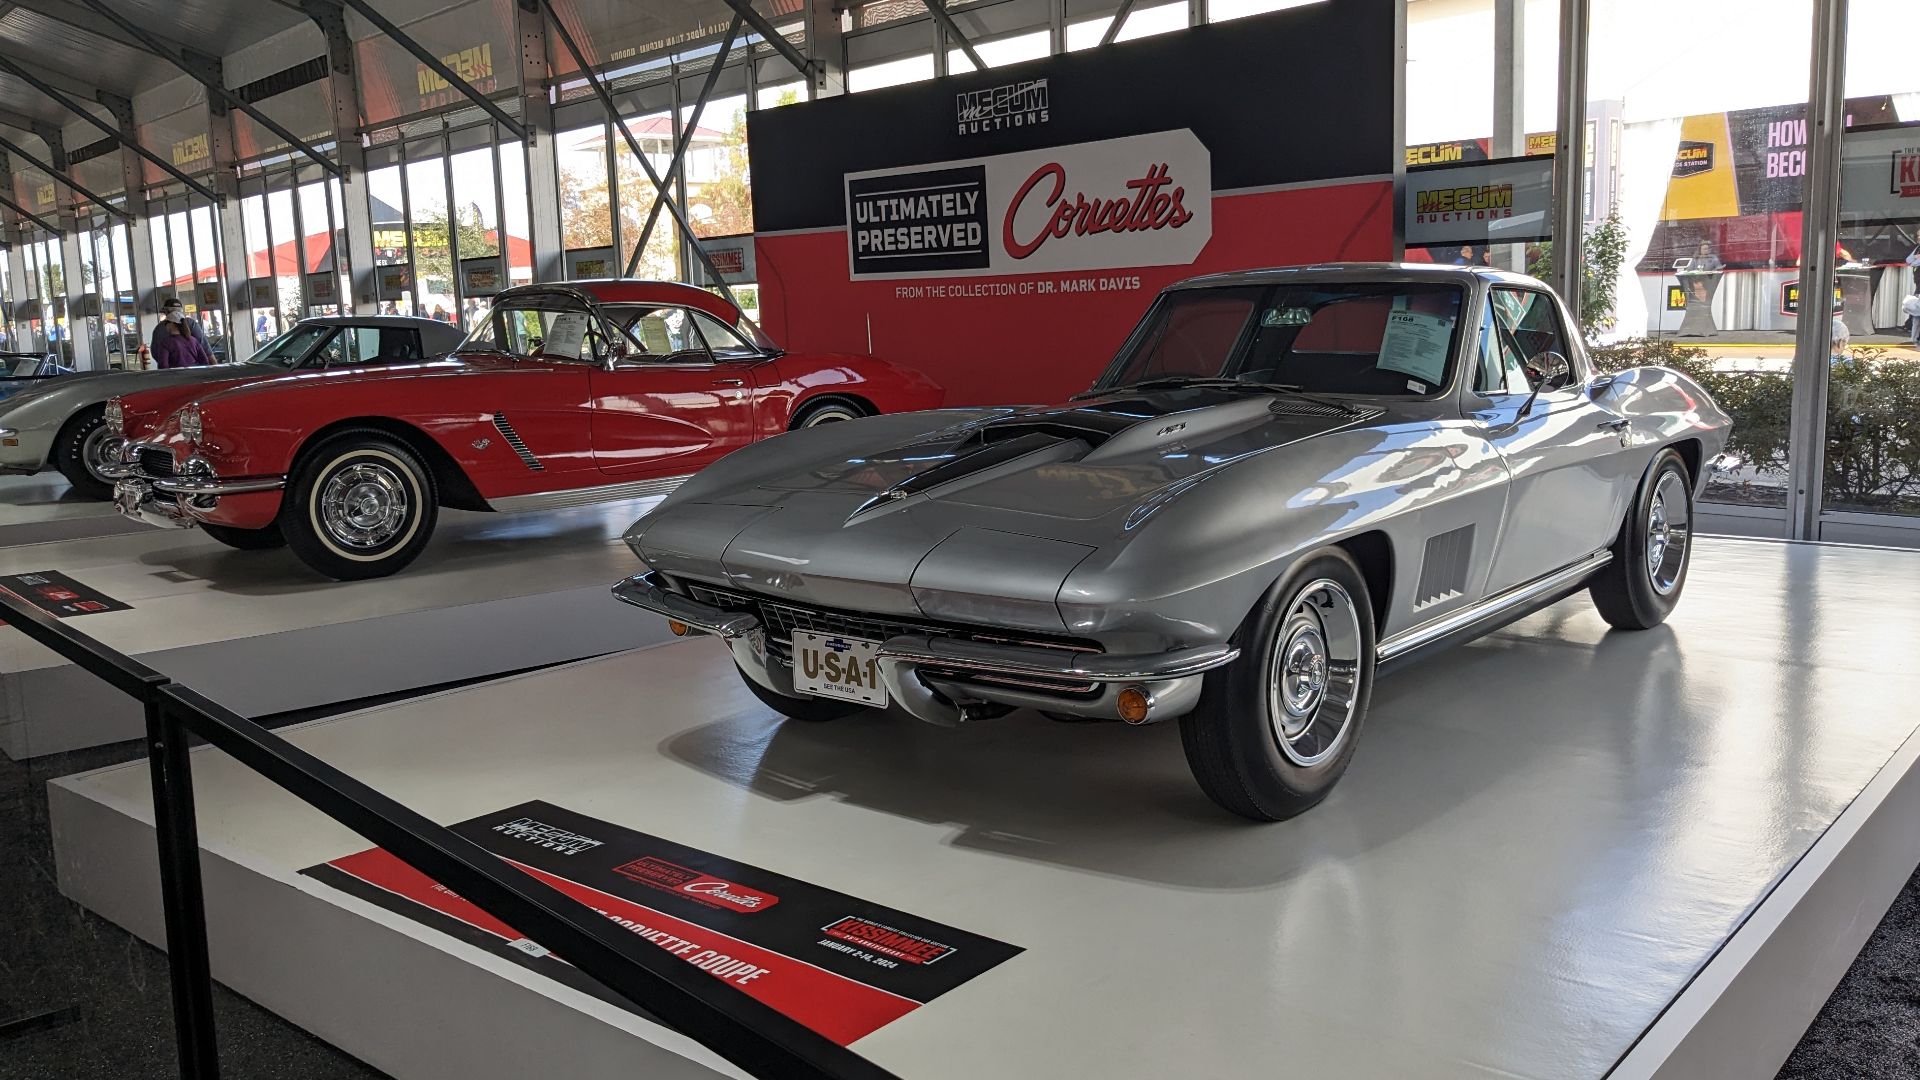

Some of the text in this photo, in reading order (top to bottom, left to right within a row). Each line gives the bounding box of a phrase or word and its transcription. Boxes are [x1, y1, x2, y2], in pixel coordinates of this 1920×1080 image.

[957, 78, 1048, 122] MECUM
[959, 110, 1048, 135] AUCTIONS
[1405, 143, 1462, 166] ECUM
[1529, 135, 1557, 150] MEC
[1677, 147, 1708, 160] CUM
[1767, 150, 1806, 178] BEC
[855, 190, 979, 224] ULTIMATELY
[1003, 161, 1194, 260] Corvettes
[1417, 183, 1513, 214] MECUM
[1417, 208, 1512, 223] AUCTIONS
[858, 221, 982, 253] PRESERVED
[895, 276, 1141, 299] FROM THE COLLECTION OF DR. MARK DAVIS
[817, 939, 856, 955] JANUARY
[871, 957, 899, 969] 2024
[832, 918, 946, 960] KISSIMMEE
[689, 949, 771, 985] COUPE
